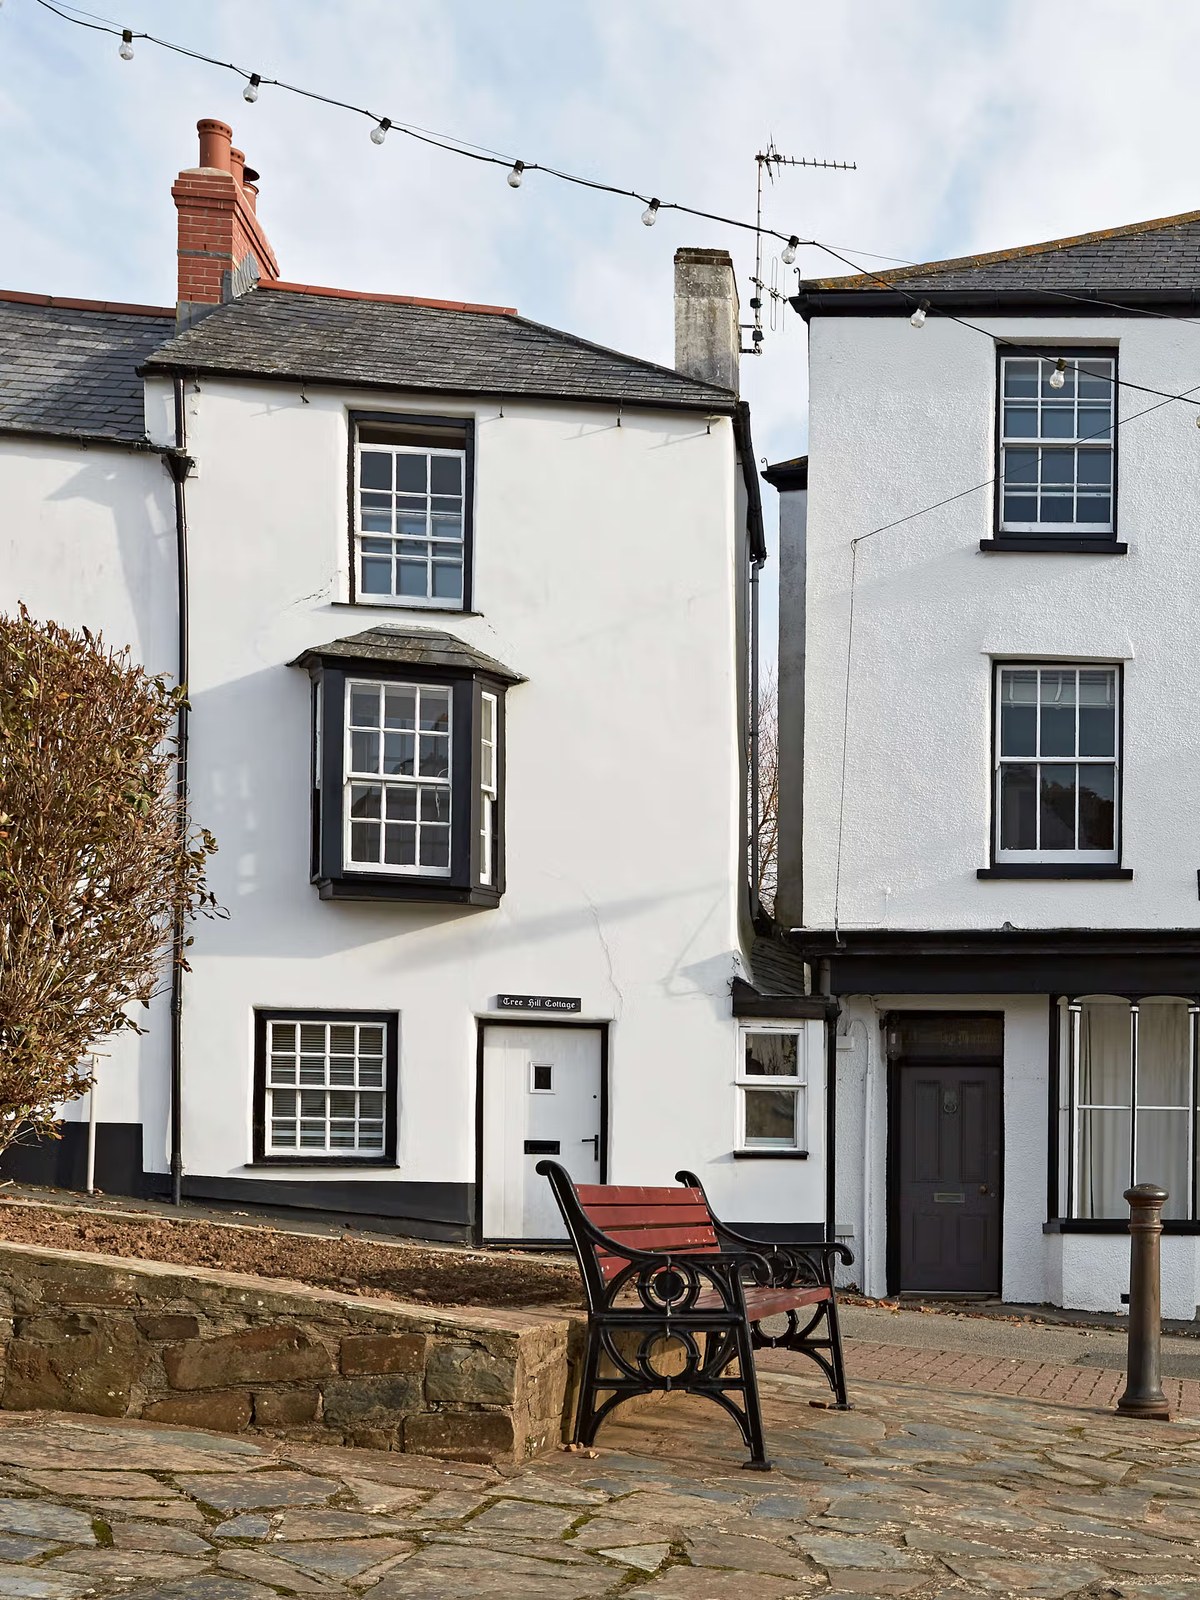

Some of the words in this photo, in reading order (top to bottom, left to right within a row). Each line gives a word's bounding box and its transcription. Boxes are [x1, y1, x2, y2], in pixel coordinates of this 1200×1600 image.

[502, 997, 523, 1006] Tree
[527, 998, 541, 1008] Hill
[544, 999, 576, 1010] Cottage
